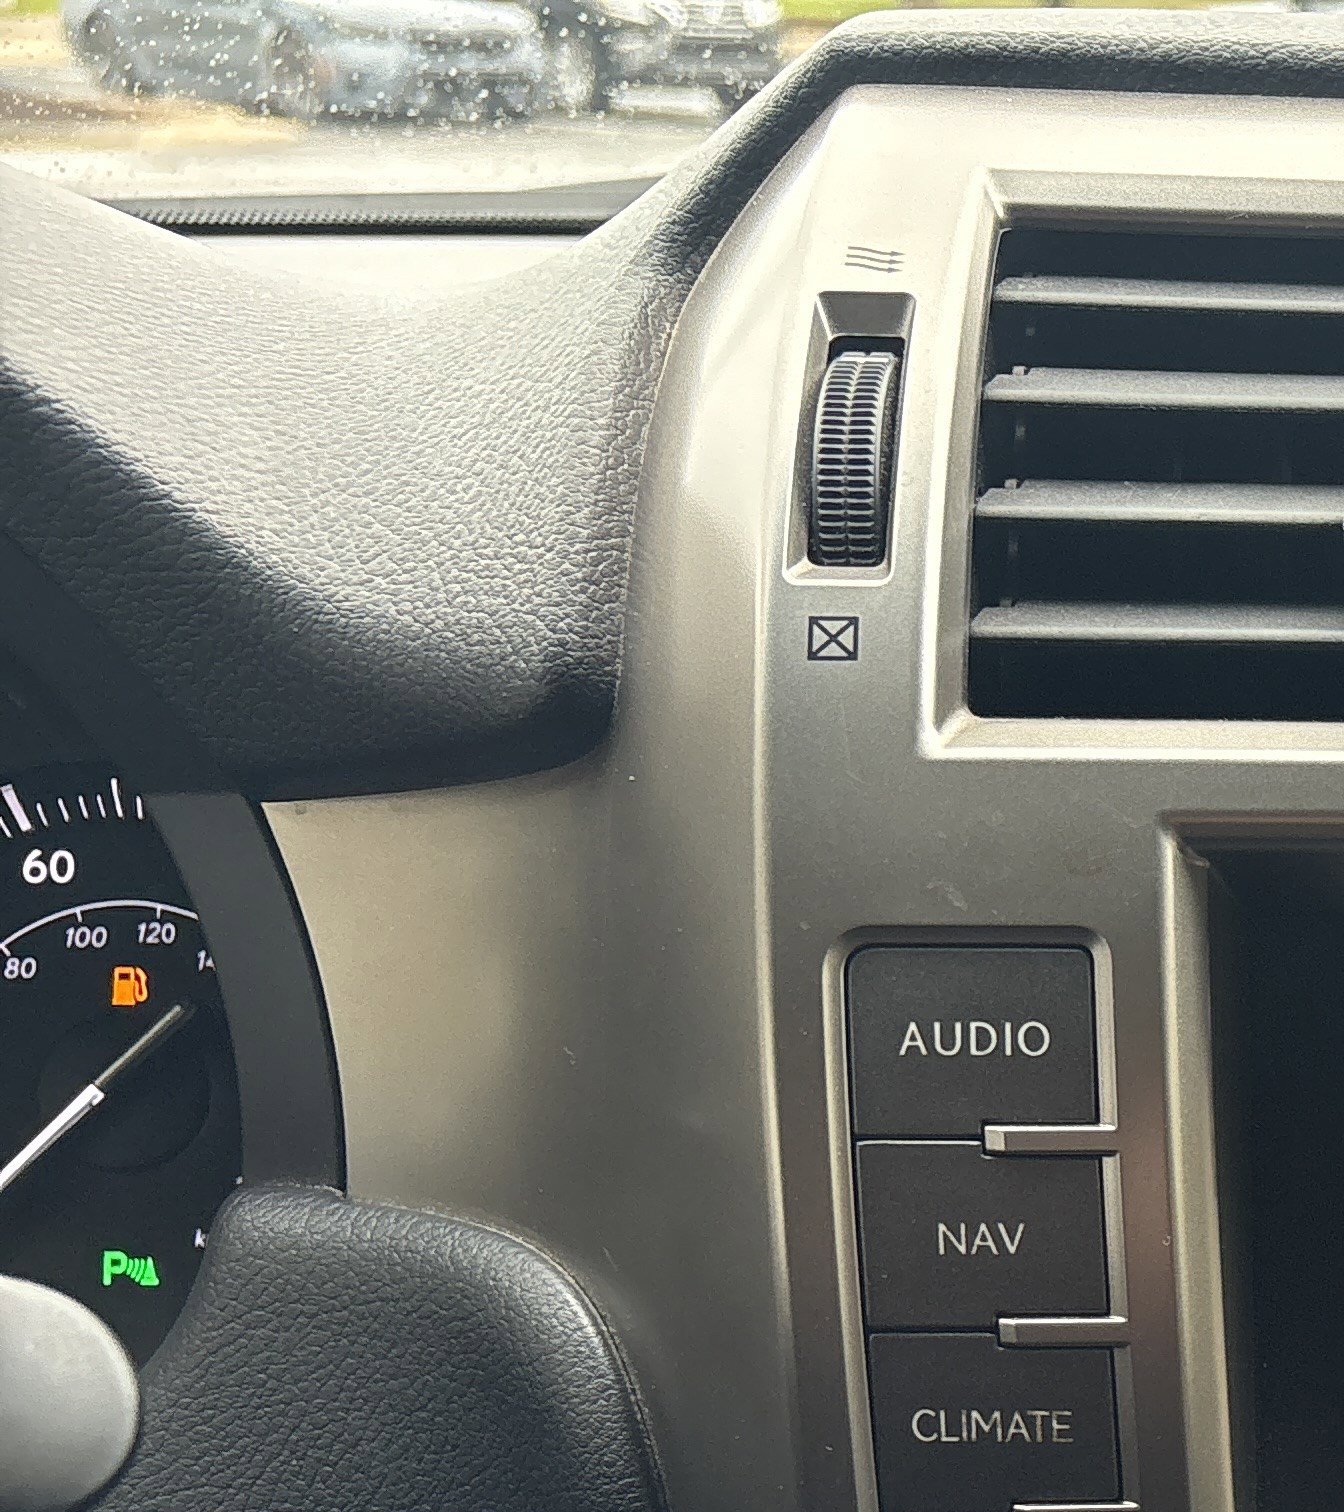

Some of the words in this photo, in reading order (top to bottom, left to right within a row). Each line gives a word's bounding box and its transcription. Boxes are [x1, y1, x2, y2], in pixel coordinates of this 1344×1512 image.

[23, 850, 75, 884] 60
[65, 927, 108, 949] 100
[137, 922, 176, 944] 120
[4, 958, 37, 979] 80
[898, 1021, 1052, 1058] AUDIO
[936, 1222, 1027, 1257] NAV
[910, 1409, 1075, 1444] CLIMATE
